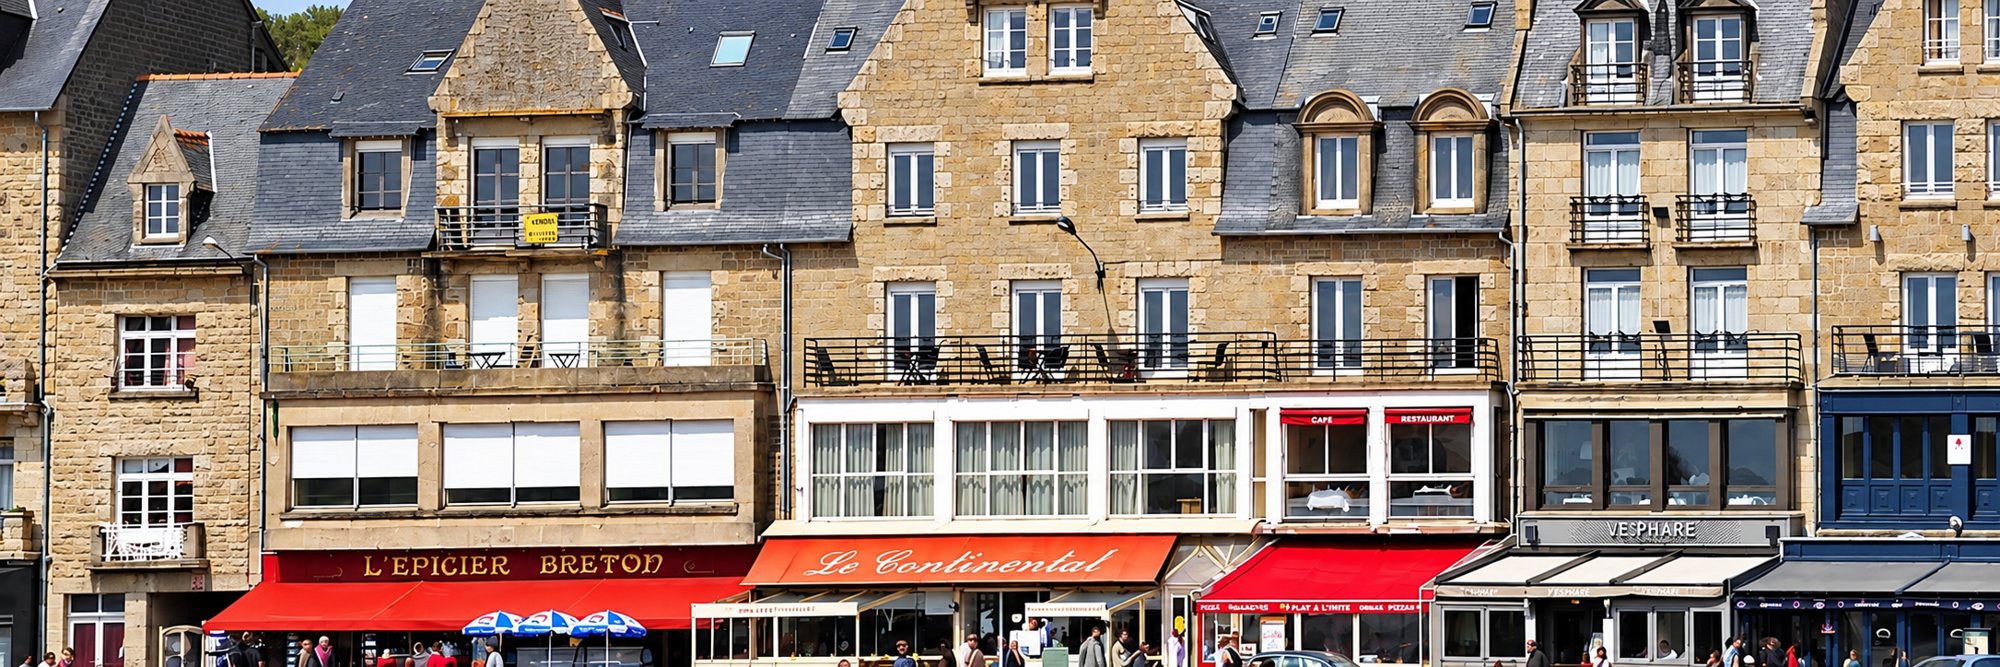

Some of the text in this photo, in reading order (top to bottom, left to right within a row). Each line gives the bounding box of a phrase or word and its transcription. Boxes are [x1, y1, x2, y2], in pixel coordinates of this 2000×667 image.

[1401, 415, 1455, 423] RESTAURANT
[1606, 520, 1697, 537] VESPHARE
[363, 553, 664, 577] L'EPICIER BRETON
[803, 548, 1119, 576] Le Continental
